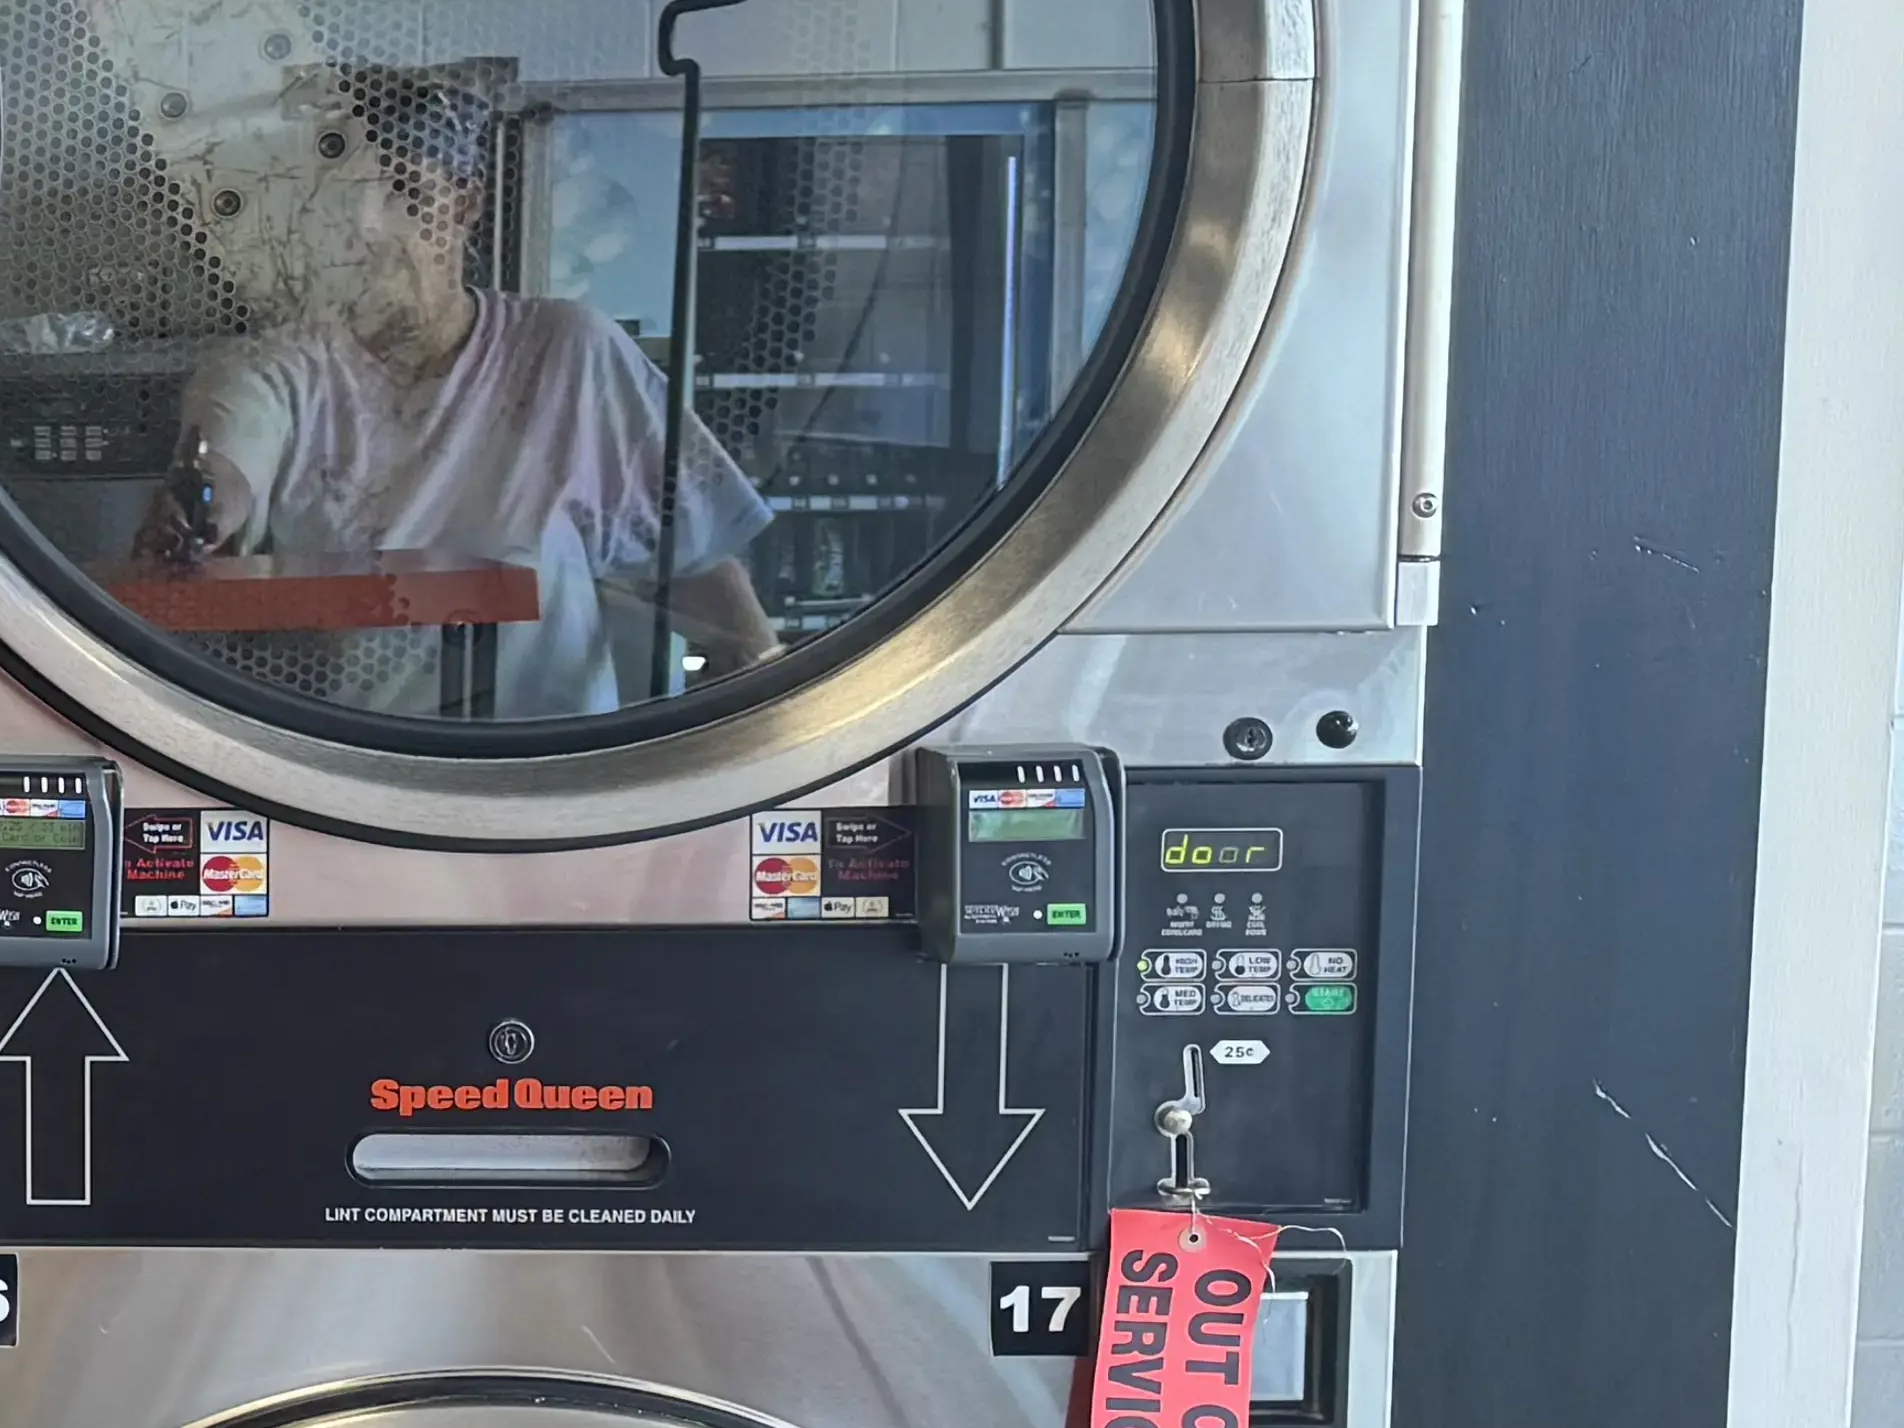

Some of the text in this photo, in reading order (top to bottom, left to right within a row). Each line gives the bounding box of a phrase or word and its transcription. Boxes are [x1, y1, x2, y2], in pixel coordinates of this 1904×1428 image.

[206, 821, 263, 841] VISA
[759, 822, 818, 842] VISA
[1166, 834, 1264, 863] door
[370, 1078, 653, 1116] Speed Queen
[325, 1209, 695, 1223] LINT COMPARTMENT MUST BE CLEANED DAILY
[1000, 1285, 1081, 1332] 17
[1185, 1269, 1252, 1386] OUT
